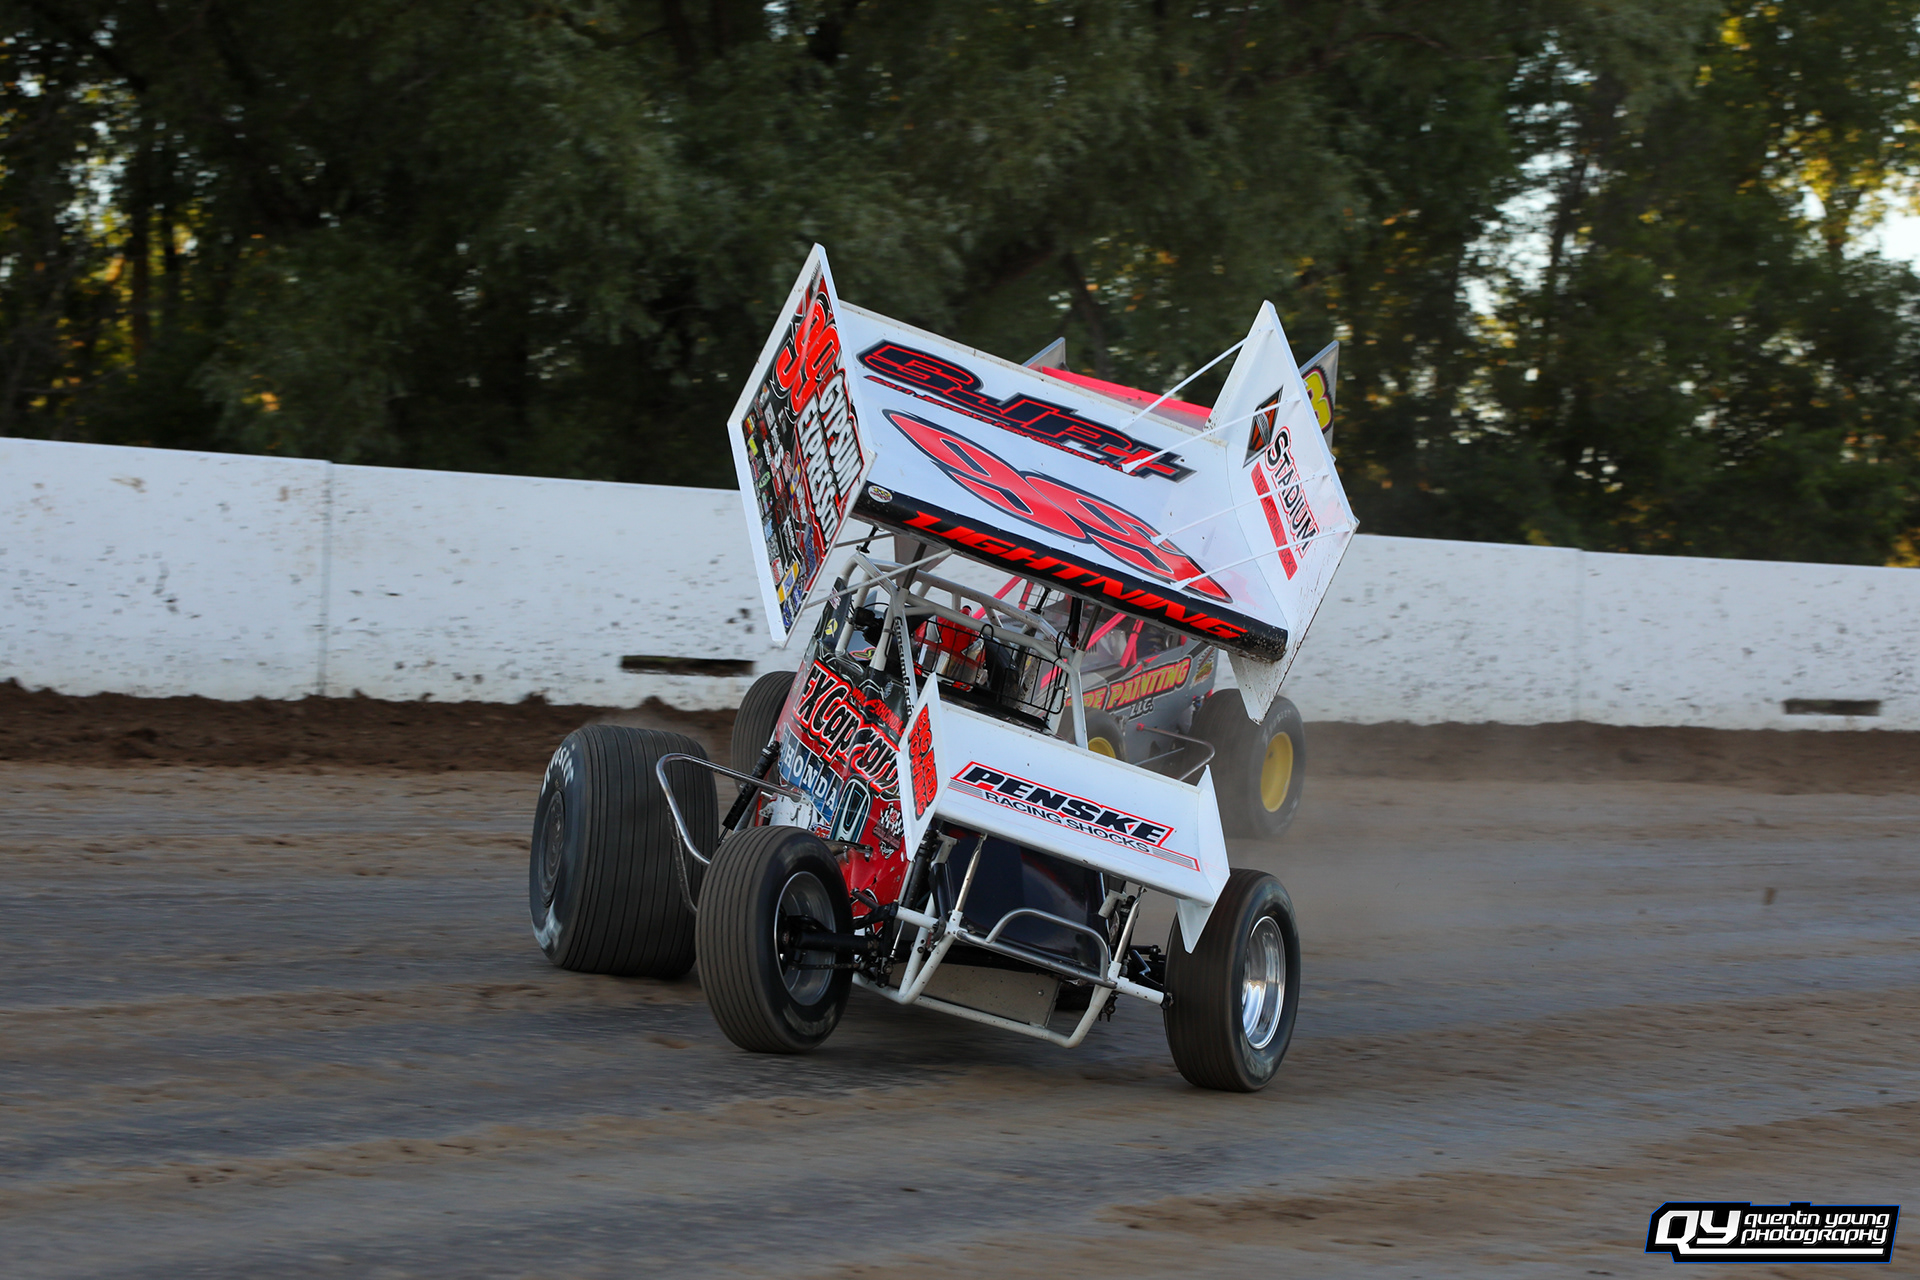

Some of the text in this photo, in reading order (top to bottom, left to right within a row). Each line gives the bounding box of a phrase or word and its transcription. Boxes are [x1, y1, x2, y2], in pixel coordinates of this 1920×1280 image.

[774, 298, 841, 416] 99
[797, 394, 836, 518] EXPRESS
[818, 373, 862, 498] GYPSUM
[882, 408, 1233, 603] 99
[1266, 430, 1318, 553] STADIUM
[903, 510, 1248, 639] LIGHTNING
[1106, 658, 1191, 711] PAINTING
[784, 743, 838, 813] HONDA
[908, 719, 928, 821] TOWING
[917, 703, 938, 807] BIG RED
[963, 766, 1166, 844] PENSKE
[985, 790, 1151, 853] RACING SHOCKS
